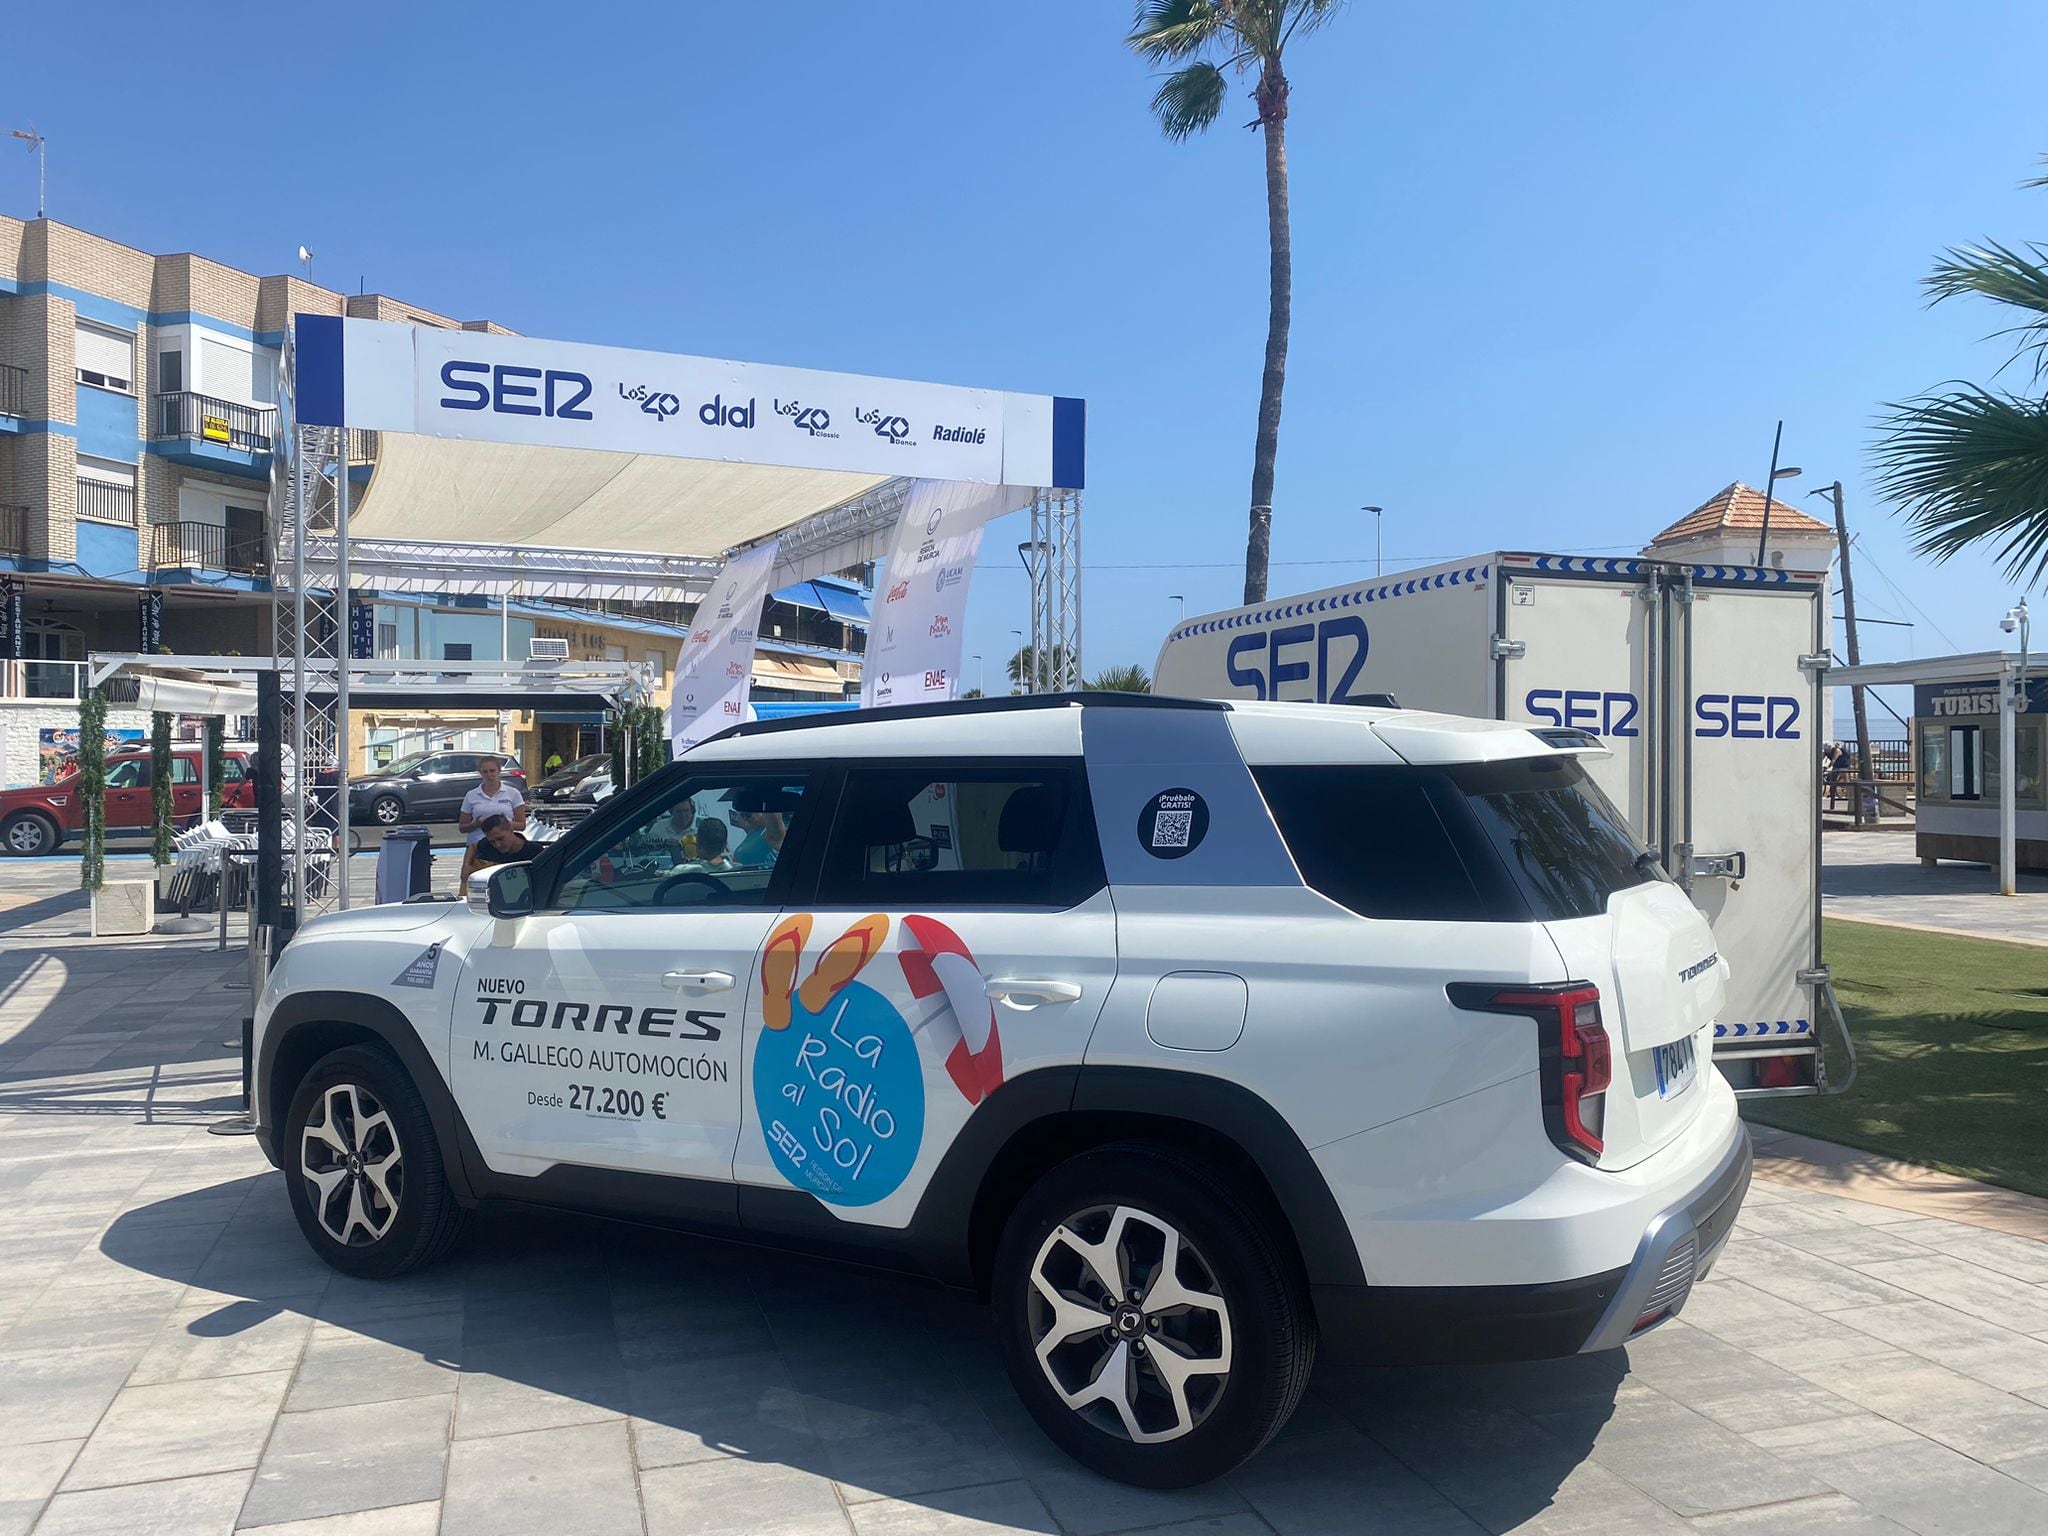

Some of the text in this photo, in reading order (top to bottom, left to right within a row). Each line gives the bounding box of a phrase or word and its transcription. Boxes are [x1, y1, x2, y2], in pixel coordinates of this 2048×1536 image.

[440, 360, 593, 421] SER
[640, 392, 680, 422] 40
[699, 394, 755, 429] dial
[793, 407, 830, 436] 40
[816, 431, 840, 439] Classic
[874, 415, 910, 444] 40
[895, 438, 917, 447] Dance
[932, 424, 986, 445] Radiolé
[14, 595, 22, 657] RESTAURANTE
[141, 604, 149, 655] RESTAURAN
[352, 606, 360, 658] HOTE
[1226, 614, 1370, 705] SER
[924, 669, 946, 688] ENAE
[1526, 689, 1639, 736] SER
[1694, 694, 1801, 740] SER
[1159, 794, 1195, 803] ¡Pruébalo
[1161, 801, 1191, 809] GRATIS!
[416, 960, 434, 969] AÑOS
[427, 942, 440, 960] 5
[477, 977, 525, 995] NUEVO
[476, 997, 726, 1042] TORRES
[831, 998, 884, 1069] La
[473, 1040, 728, 1083] M. GALLEGO AUTOMOCIÓN
[527, 1091, 563, 1108] Desde
[568, 1084, 645, 1117] 27.200
[781, 1083, 807, 1107] al
[795, 1032, 896, 1139] Radio
[767, 1119, 808, 1169] SER
[812, 1107, 874, 1181] Sol
